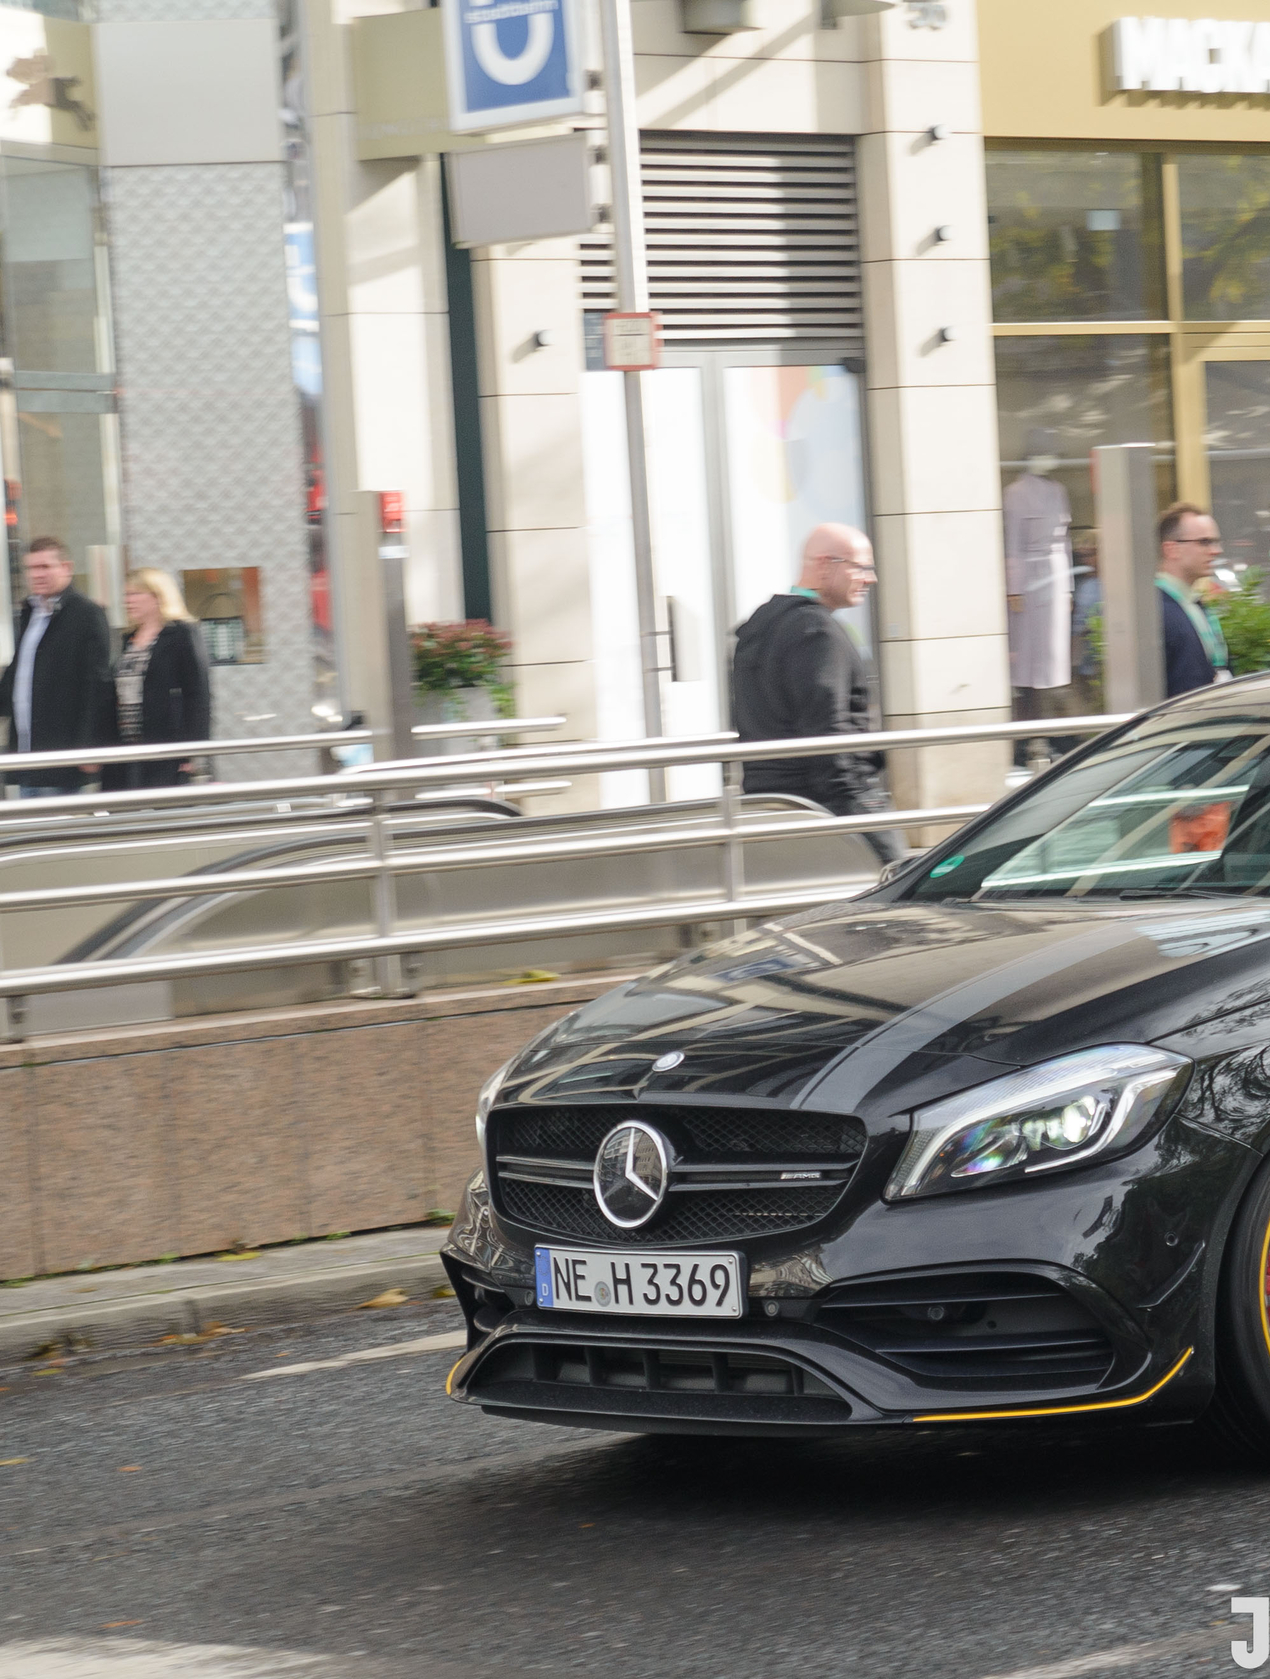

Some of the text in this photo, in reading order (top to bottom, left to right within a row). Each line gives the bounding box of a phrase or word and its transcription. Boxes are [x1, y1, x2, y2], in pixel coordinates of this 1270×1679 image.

[541, 1283, 549, 1296] D
[553, 1257, 731, 1307] NE H 3369
